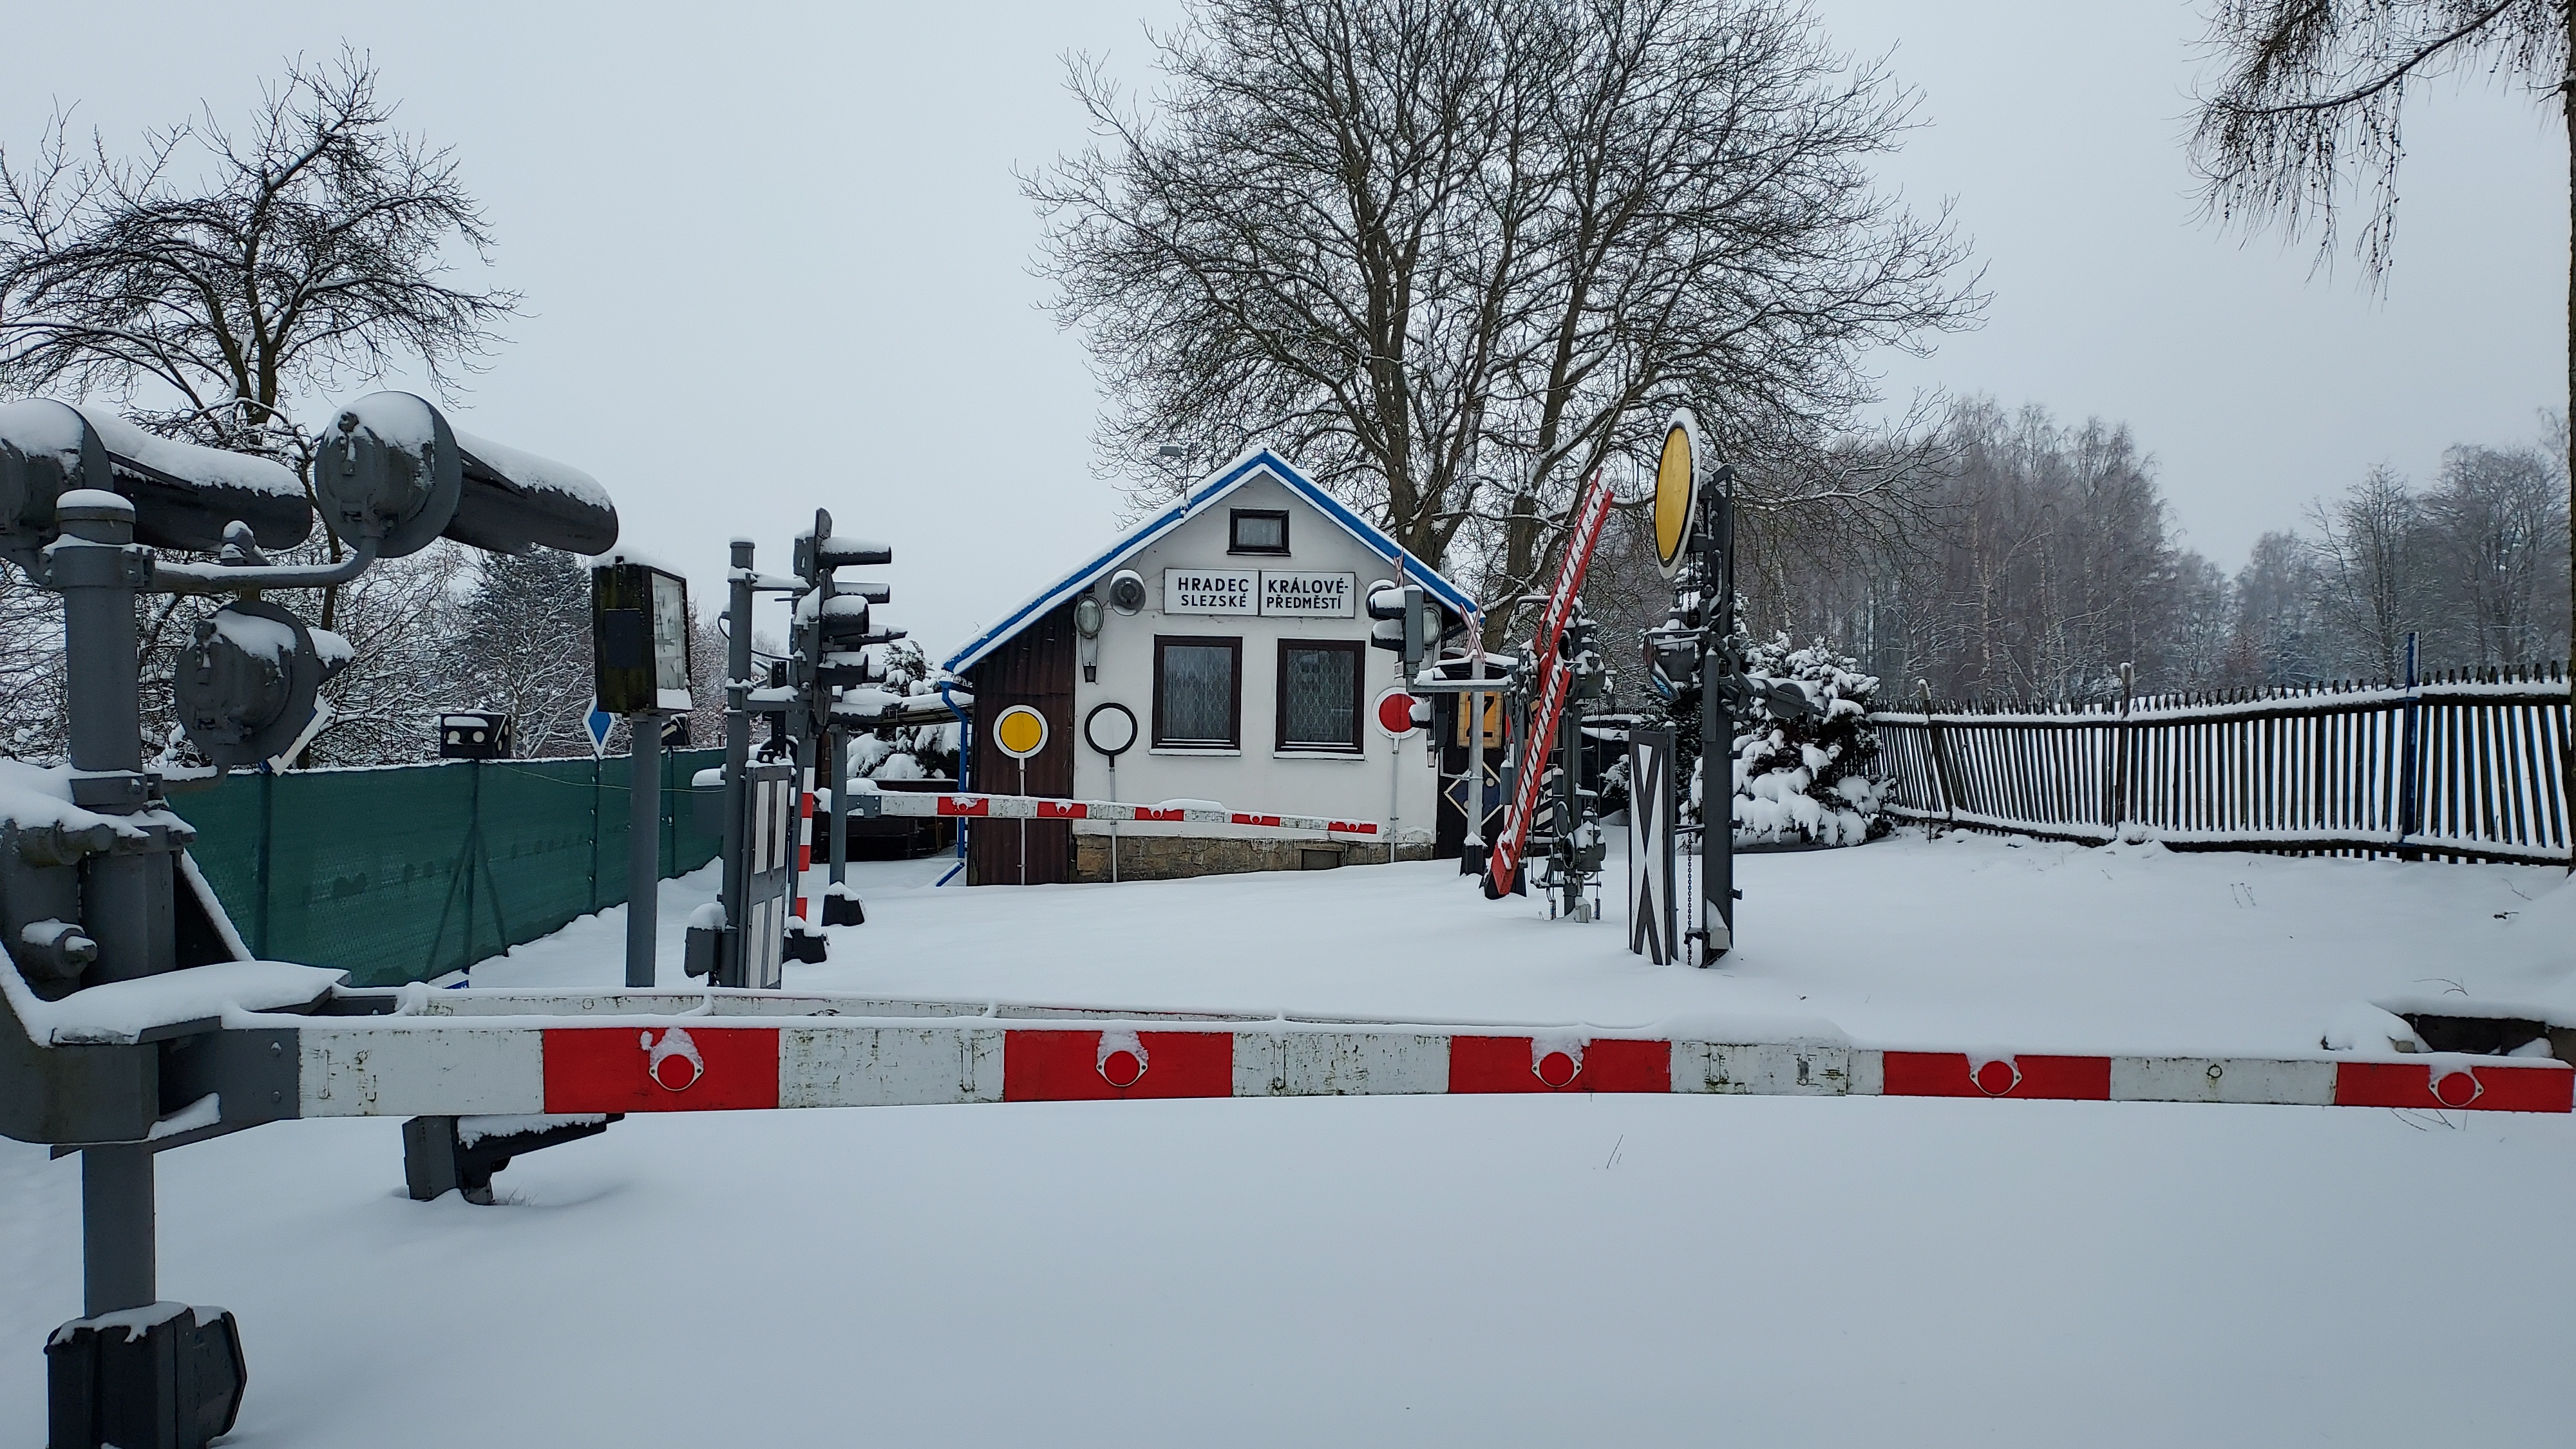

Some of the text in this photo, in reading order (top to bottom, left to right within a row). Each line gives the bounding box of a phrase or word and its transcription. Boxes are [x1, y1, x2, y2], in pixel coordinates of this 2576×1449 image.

[1178, 577, 1249, 592] HRADEC
[1268, 576, 1349, 594] KRÁLOVÉ-
[1180, 592, 1247, 607] SLEZSKÉ
[1267, 594, 1341, 609] PŘEDMĚSTÍ
